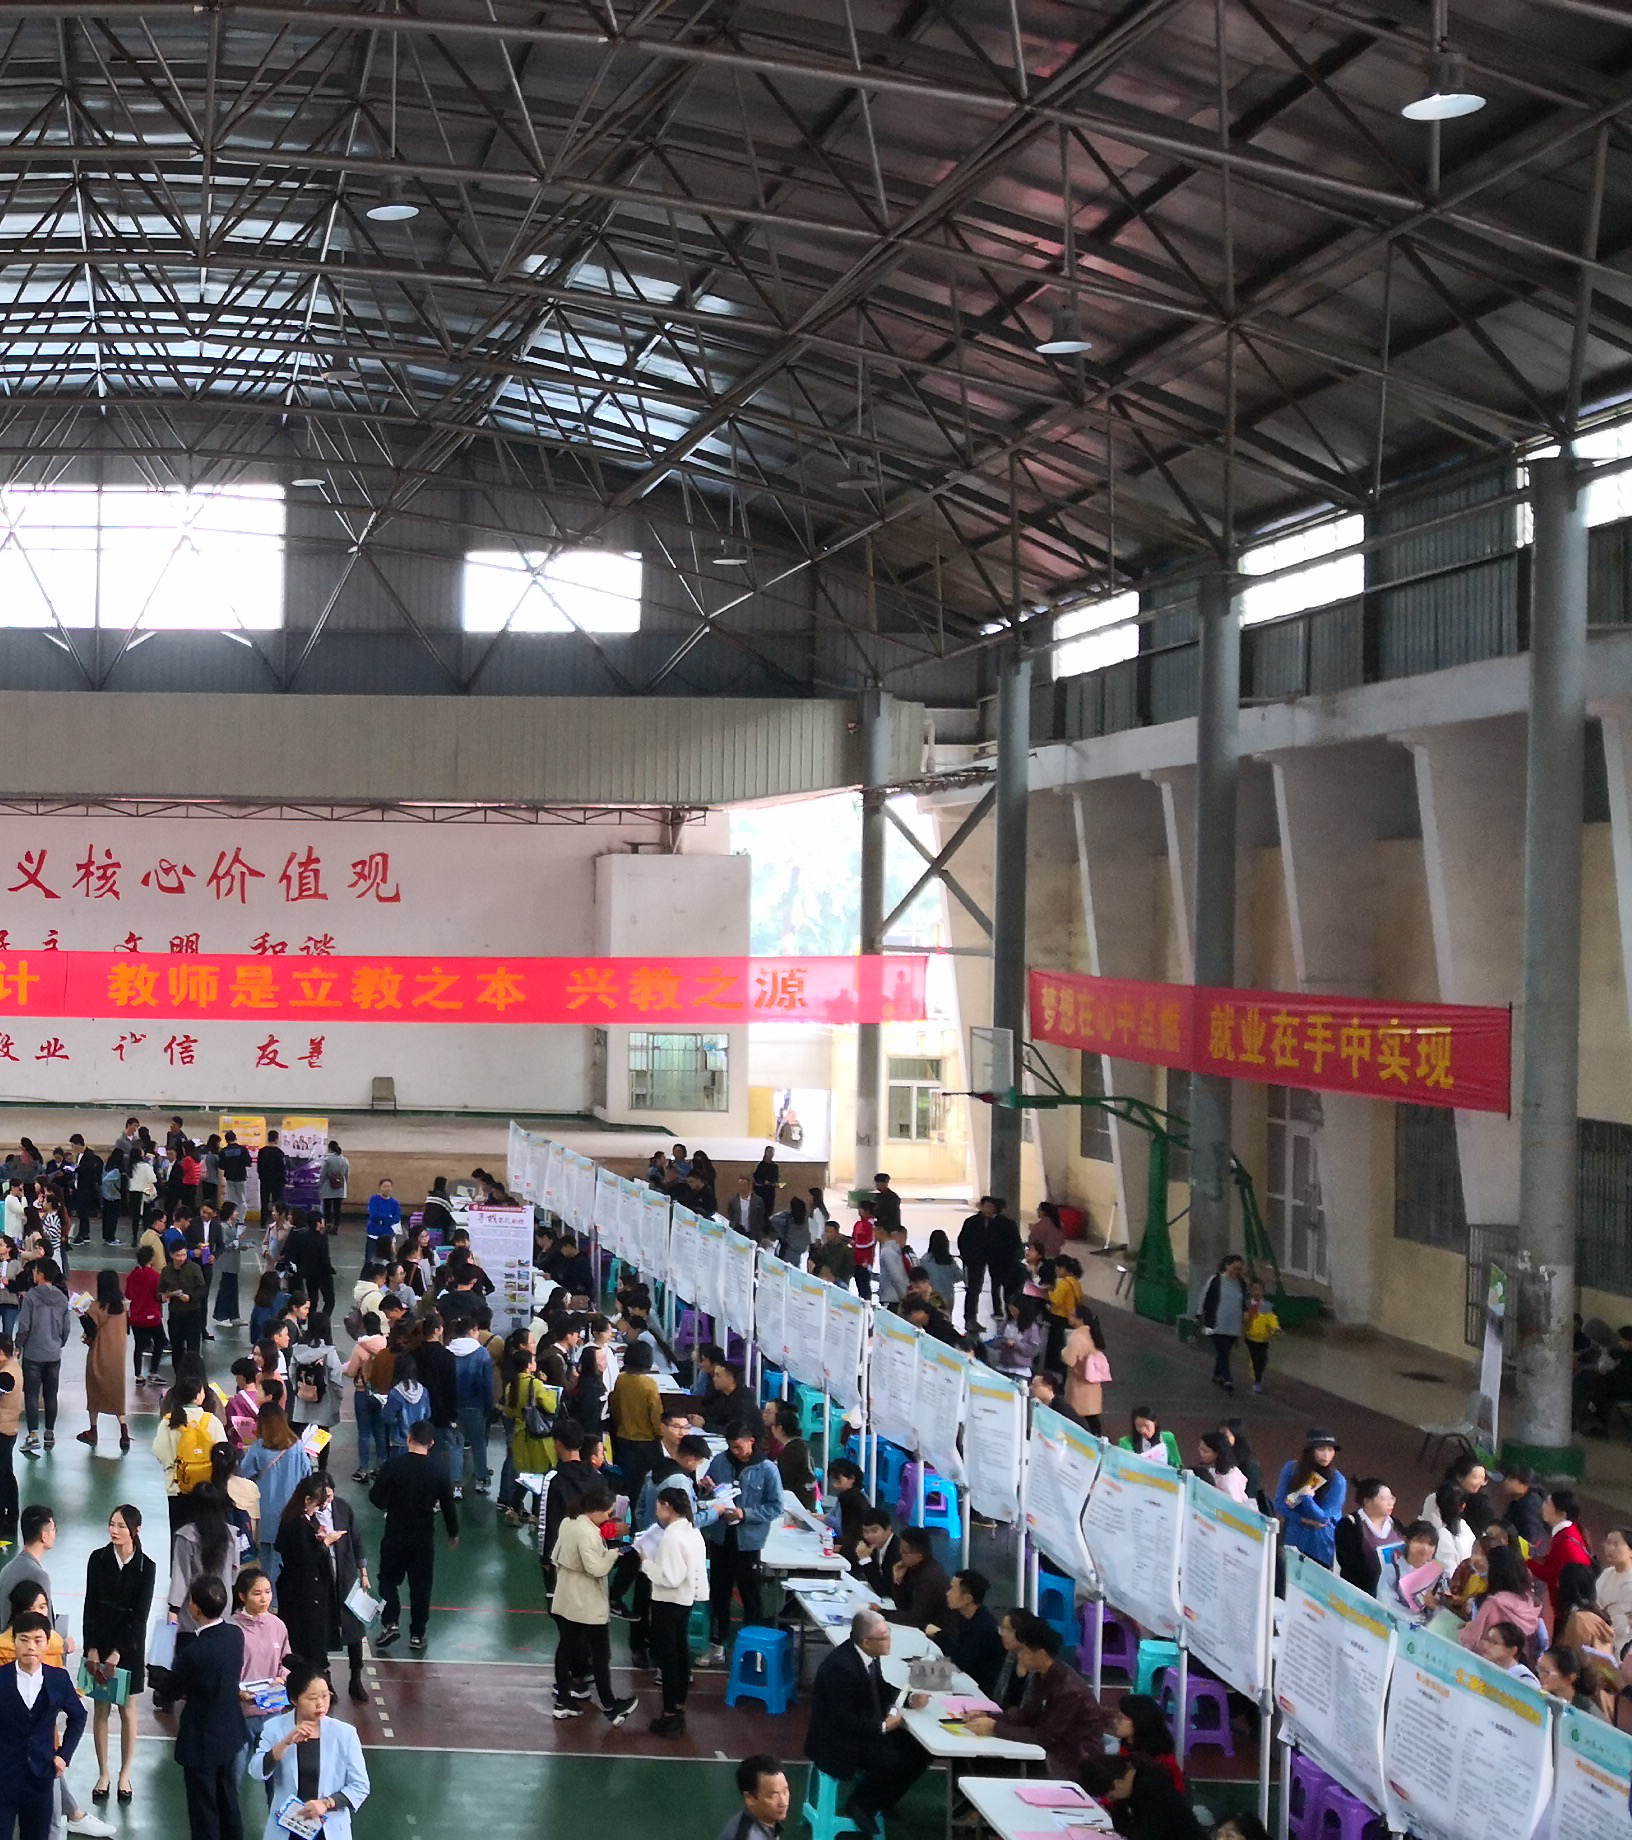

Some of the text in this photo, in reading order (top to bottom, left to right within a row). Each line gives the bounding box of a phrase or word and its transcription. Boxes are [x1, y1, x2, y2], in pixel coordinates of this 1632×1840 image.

[107, 962, 526, 1011] 教师是立教之本
[566, 966, 809, 1012] 兴教之源
[1209, 1002, 1455, 1090] 就业在手中实现
